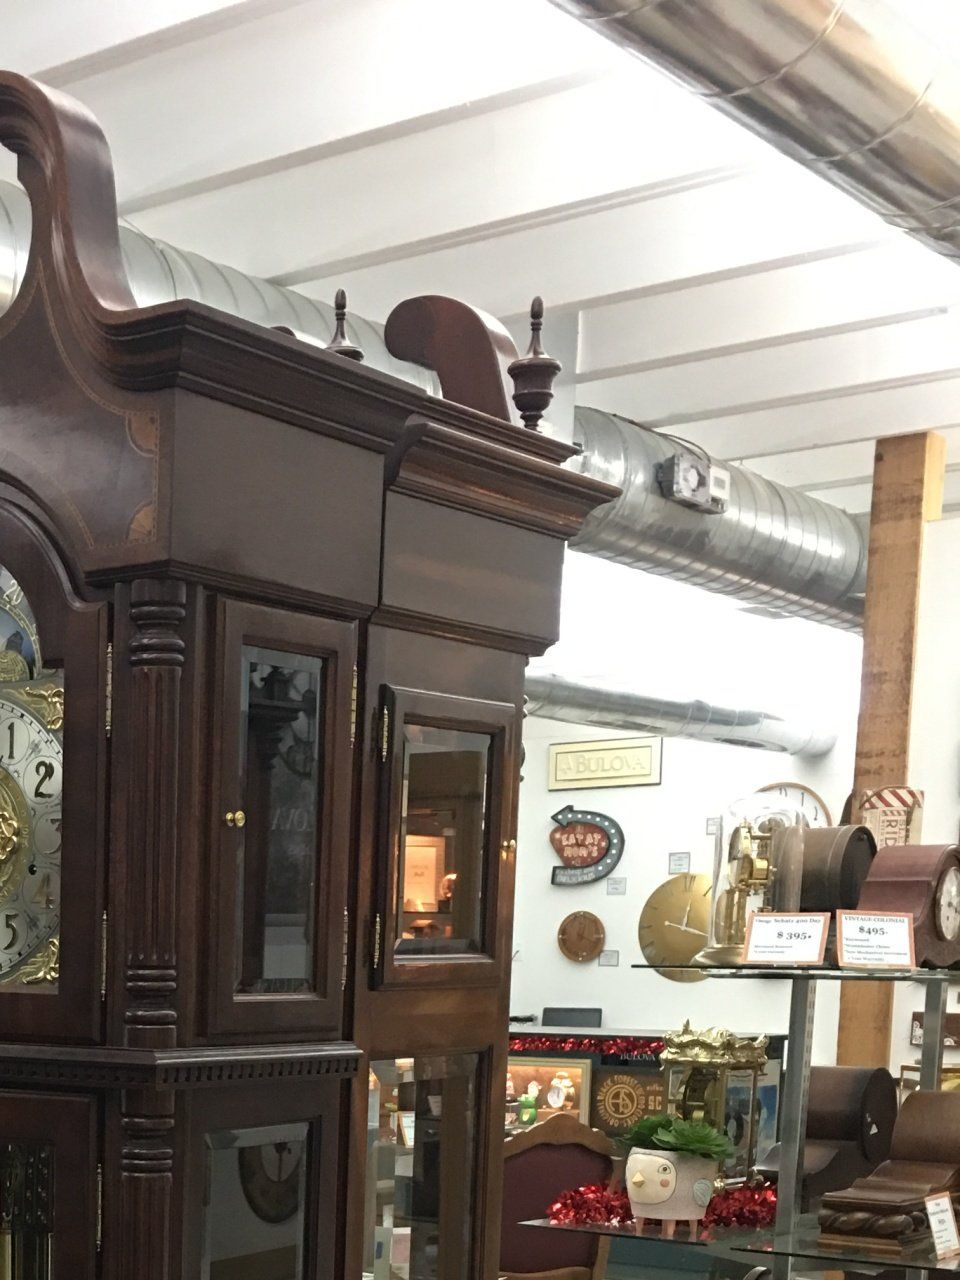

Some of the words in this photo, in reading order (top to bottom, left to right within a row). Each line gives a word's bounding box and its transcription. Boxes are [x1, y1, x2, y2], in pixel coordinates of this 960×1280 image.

[3, 580, 24, 605] 20
[8, 722, 15, 760] 1
[576, 754, 646, 774] BULOVA
[34, 760, 55, 798] 2
[561, 833, 584, 846] EAT
[585, 833, 601, 845] AT
[4, 914, 20, 950] 5
[777, 931, 784, 939] $
